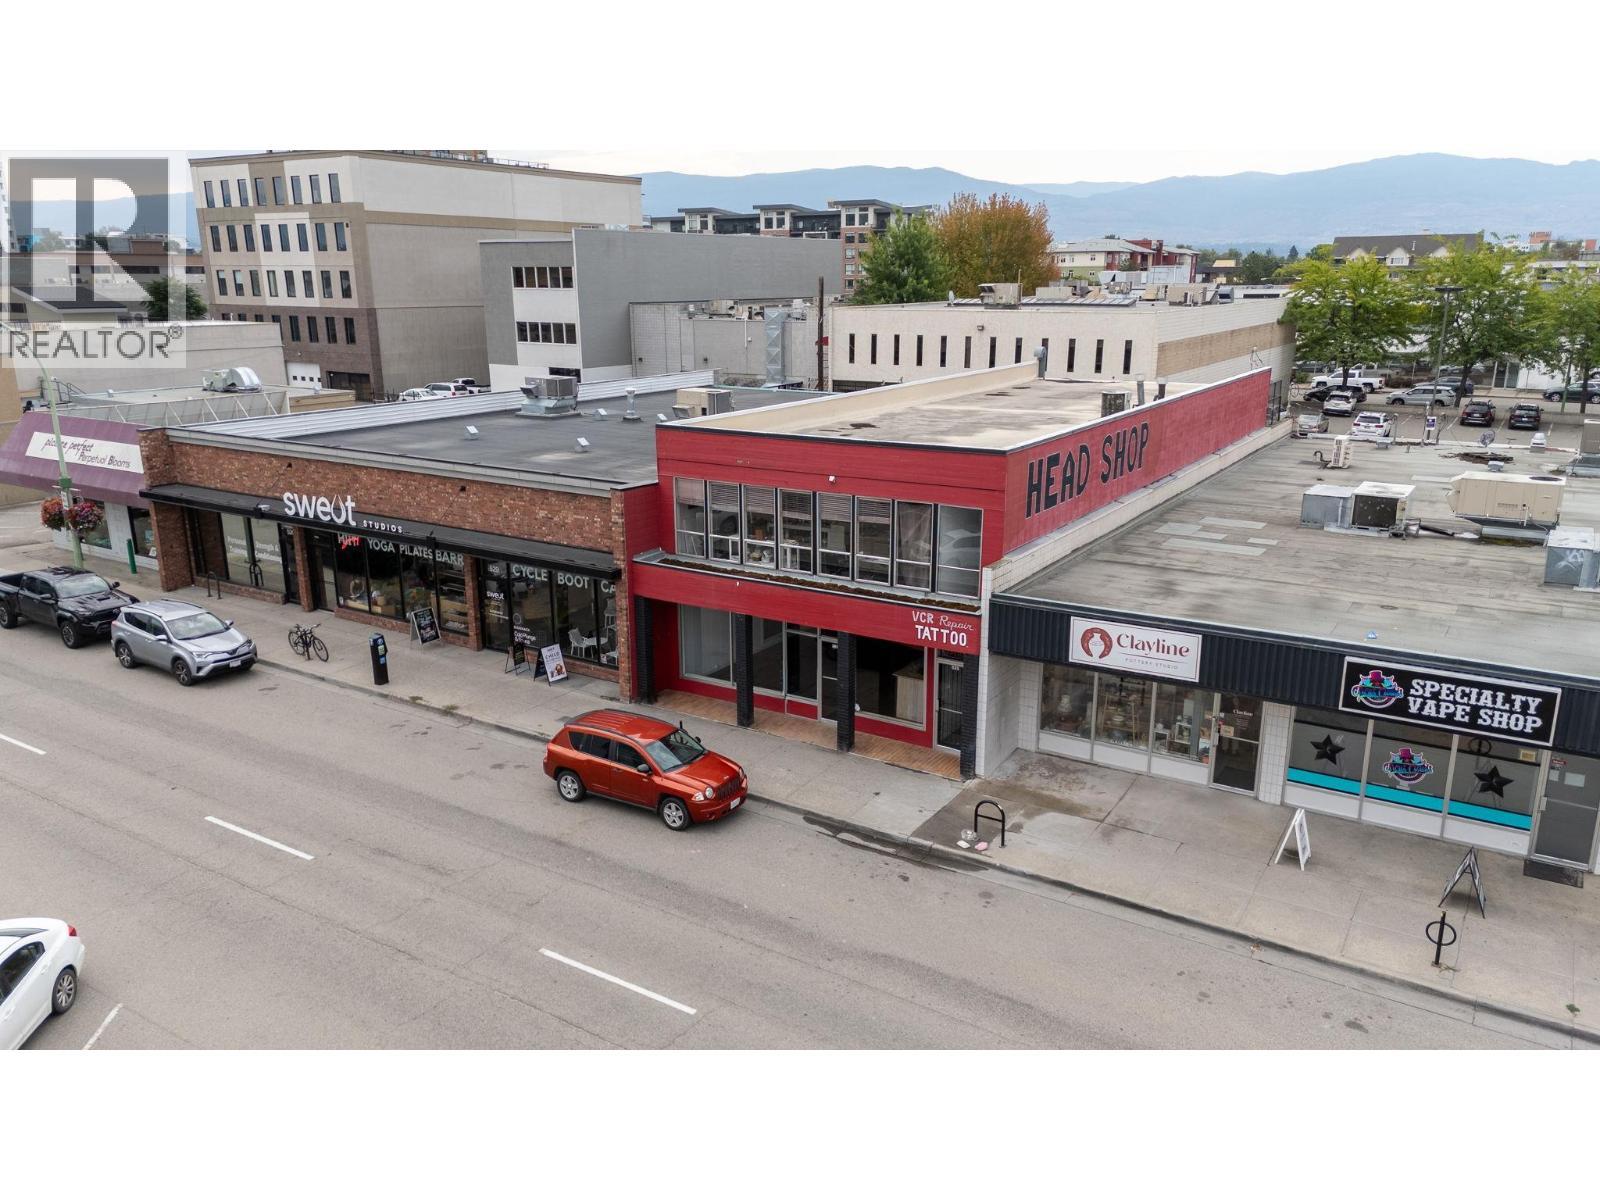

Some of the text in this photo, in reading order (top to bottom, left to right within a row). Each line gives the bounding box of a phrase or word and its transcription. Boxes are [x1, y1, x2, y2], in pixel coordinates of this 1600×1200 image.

[65, 439, 94, 456] perfect
[79, 451, 131, 469] Perpetual Blooms
[1025, 422, 1149, 519] HEAD SHOP
[362, 519, 403, 534] STUDIOS
[367, 538, 396, 554] YOGA
[399, 544, 433, 559] PILATES
[512, 563, 549, 582] CYCLE
[557, 572, 590, 589] BOOT
[912, 610, 975, 631] VCR Repair
[914, 624, 967, 647] TATTOO
[1116, 632, 1190, 658] Clayline
[1409, 678, 1543, 715] SPECIALTY
[1407, 696, 1543, 733] VAPE SHOP
